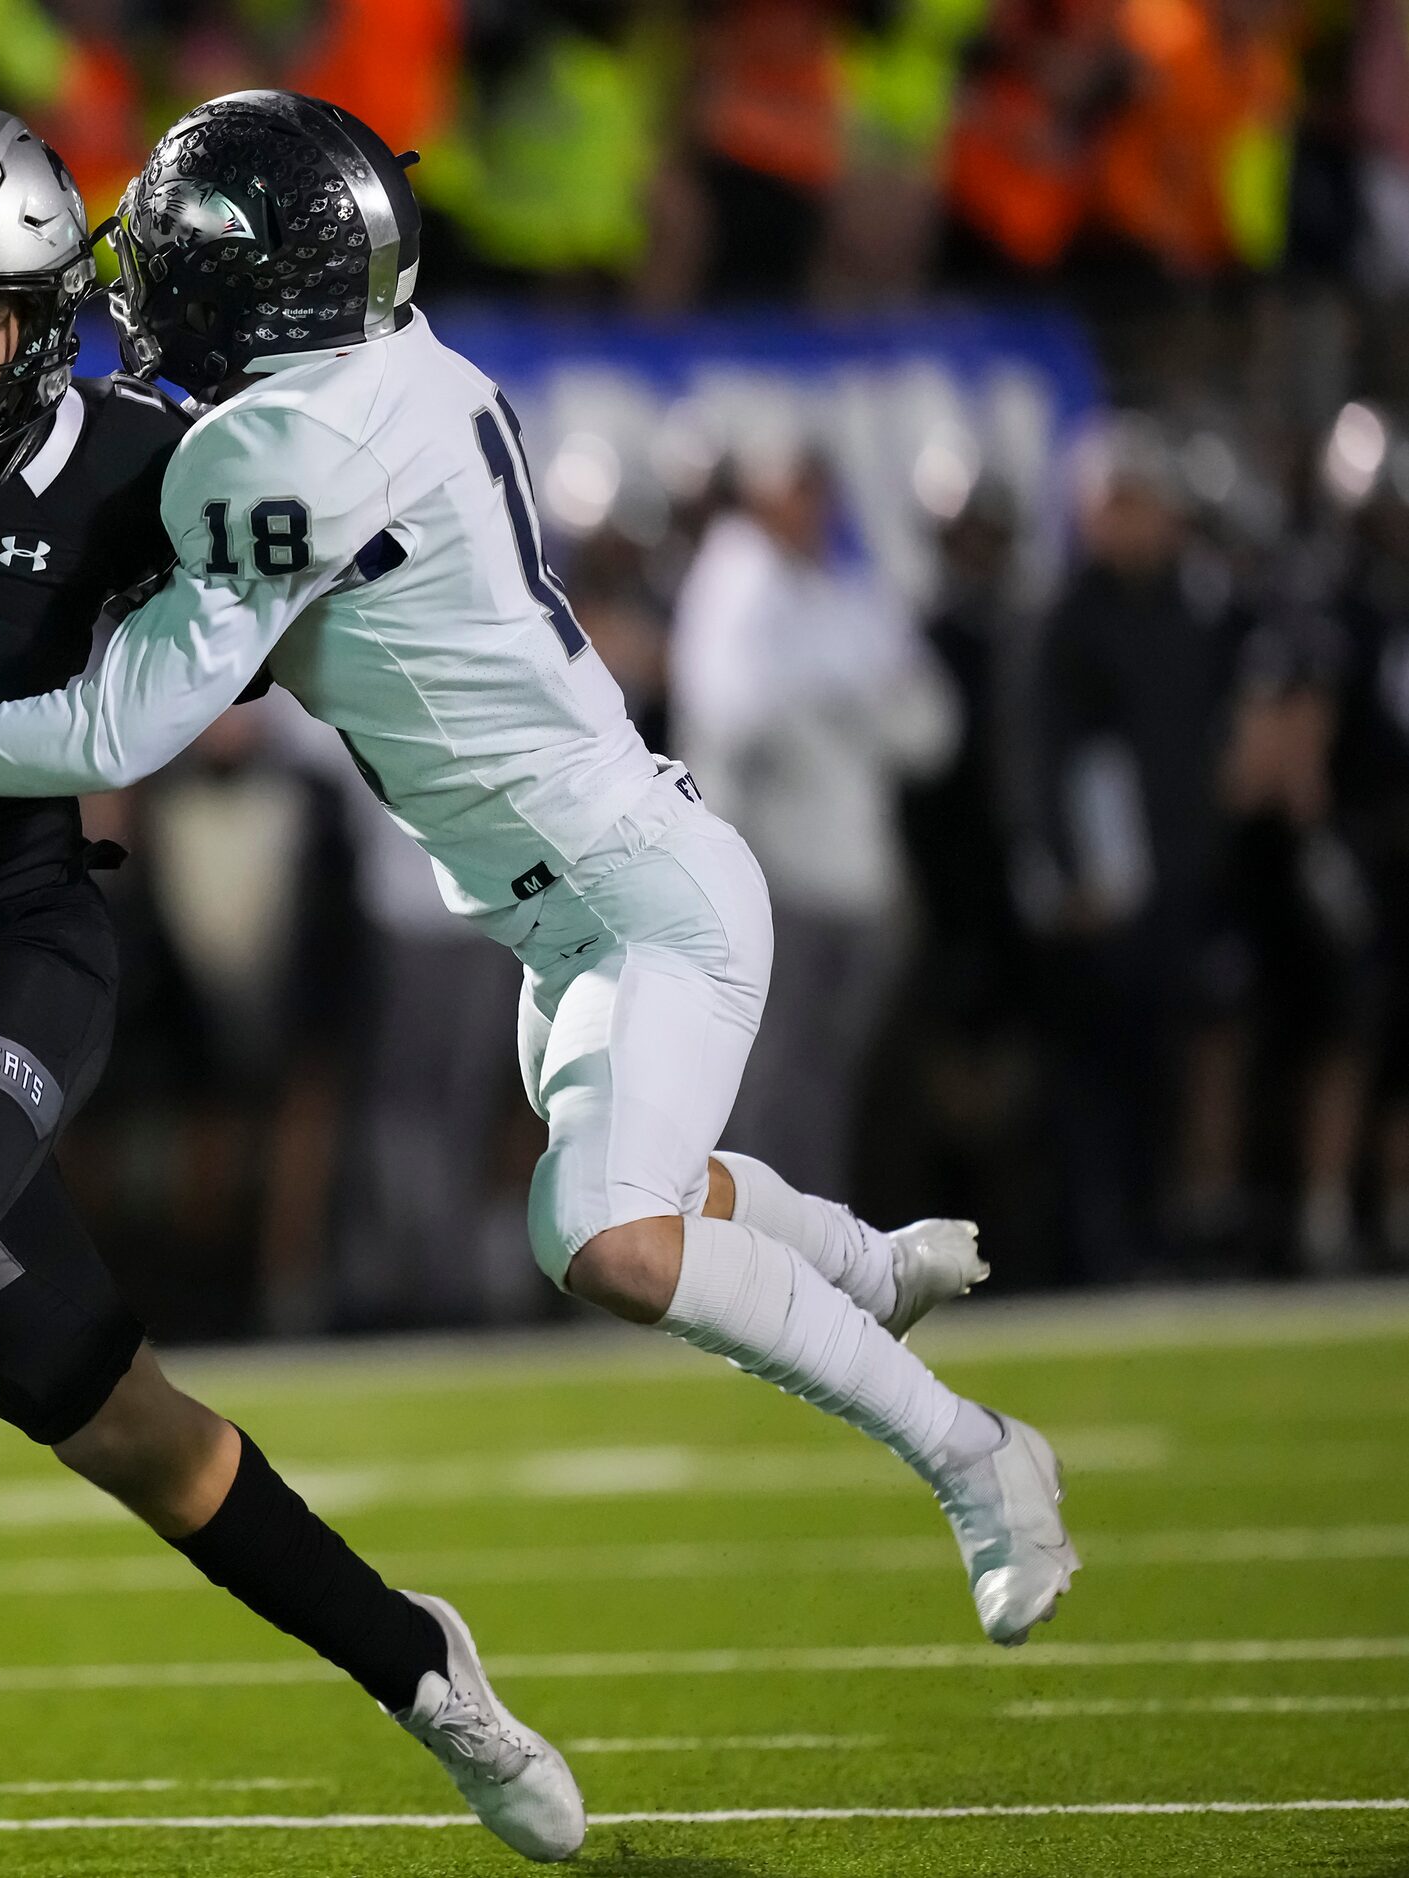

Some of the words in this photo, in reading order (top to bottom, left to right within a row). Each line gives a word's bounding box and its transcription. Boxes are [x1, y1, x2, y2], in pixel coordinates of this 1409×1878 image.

[13, 327, 58, 377] Ridll
[200, 497, 314, 579] 18
[469, 382, 590, 665] 1
[522, 875, 543, 894] M
